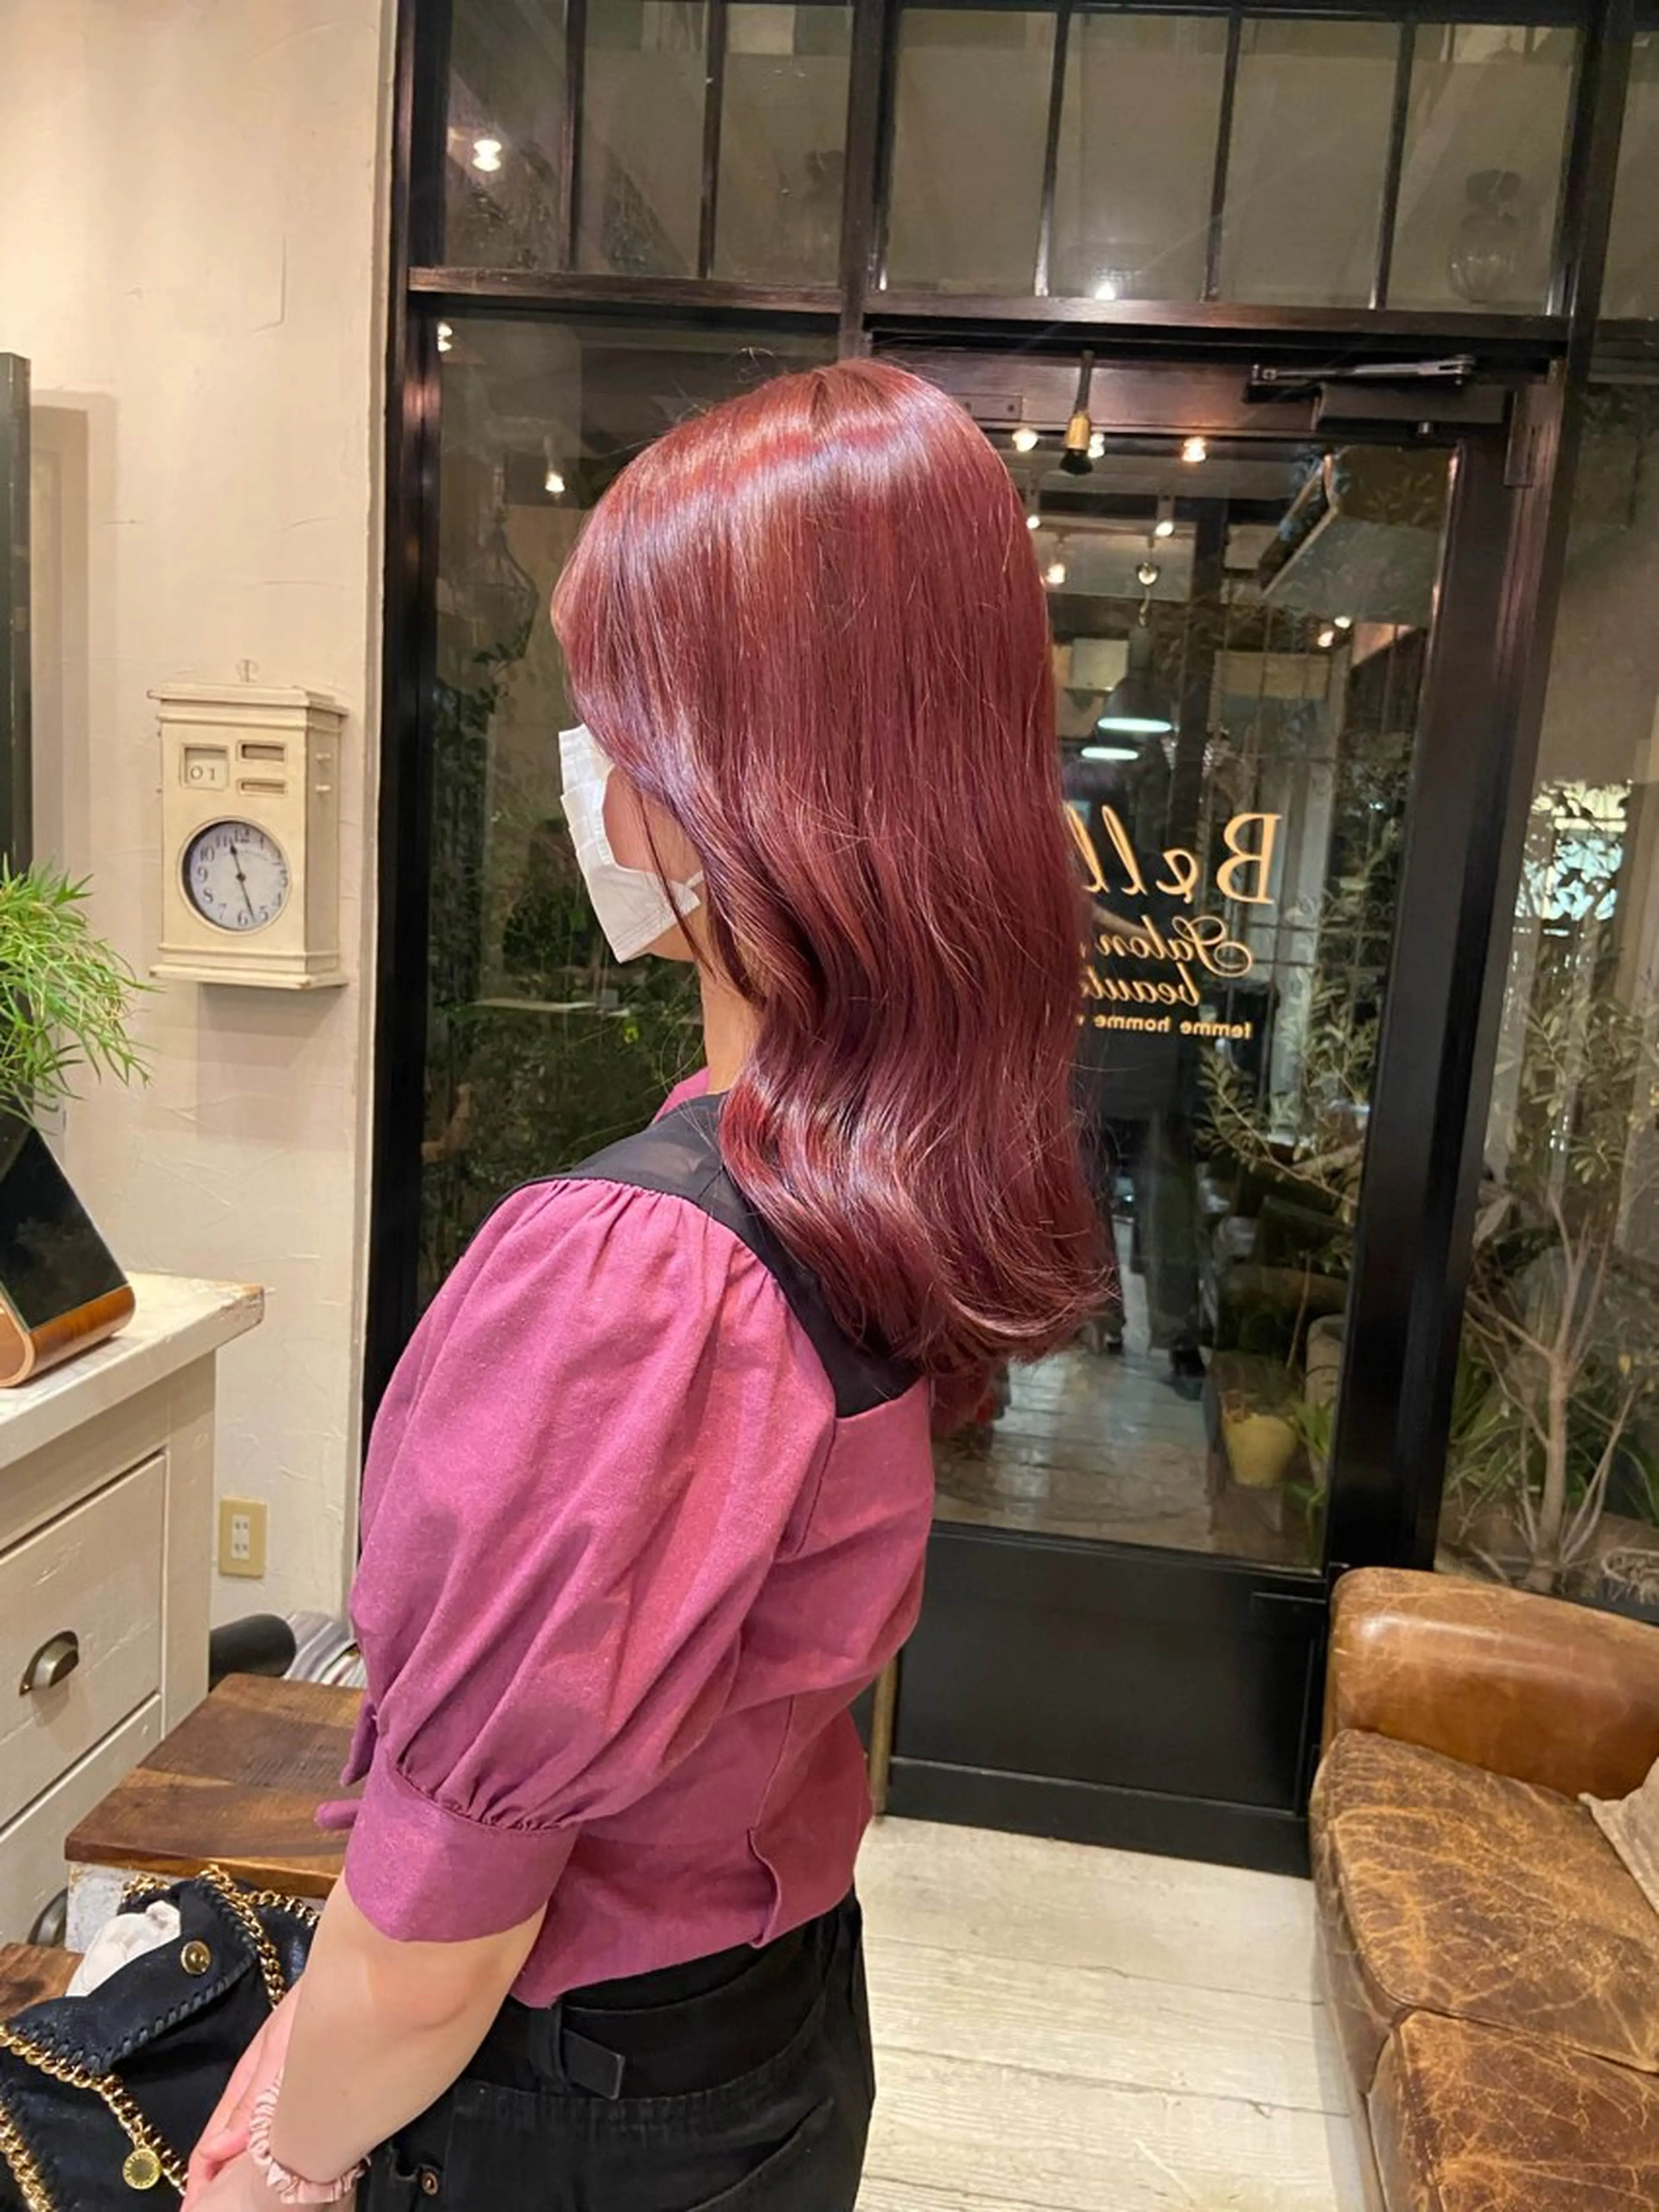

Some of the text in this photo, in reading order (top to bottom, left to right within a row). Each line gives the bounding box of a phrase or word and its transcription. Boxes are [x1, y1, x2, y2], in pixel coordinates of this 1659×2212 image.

[189, 765, 216, 782] 01
[216, 835, 228, 848] 11
[234, 827, 250, 842] 12
[200, 845, 215, 862] 10
[197, 865, 208, 882] 9
[202, 887, 214, 903] 8
[218, 903, 227, 920] 7
[237, 909, 249, 925] 6
[259, 905, 270, 922] 5
